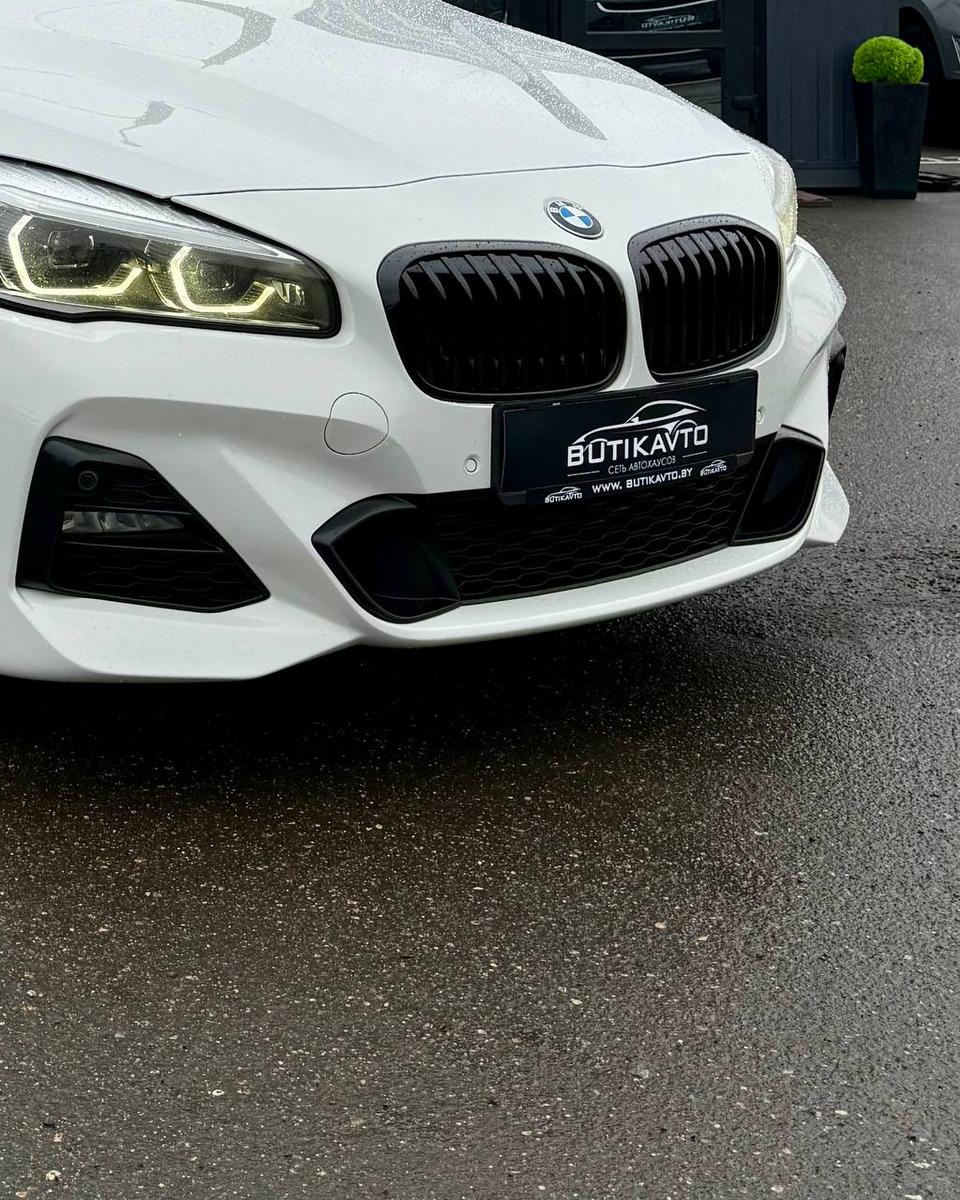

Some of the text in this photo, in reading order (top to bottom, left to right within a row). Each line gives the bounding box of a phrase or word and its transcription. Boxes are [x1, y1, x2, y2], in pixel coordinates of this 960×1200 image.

[567, 423, 709, 468] BUTIKAVTO
[607, 455, 676, 475] СЕТЬ АВТОХАУСОВ
[591, 467, 693, 494] WWW. BUTIKAVTO.BY
[544, 492, 583, 504] BUTIKAVTO
